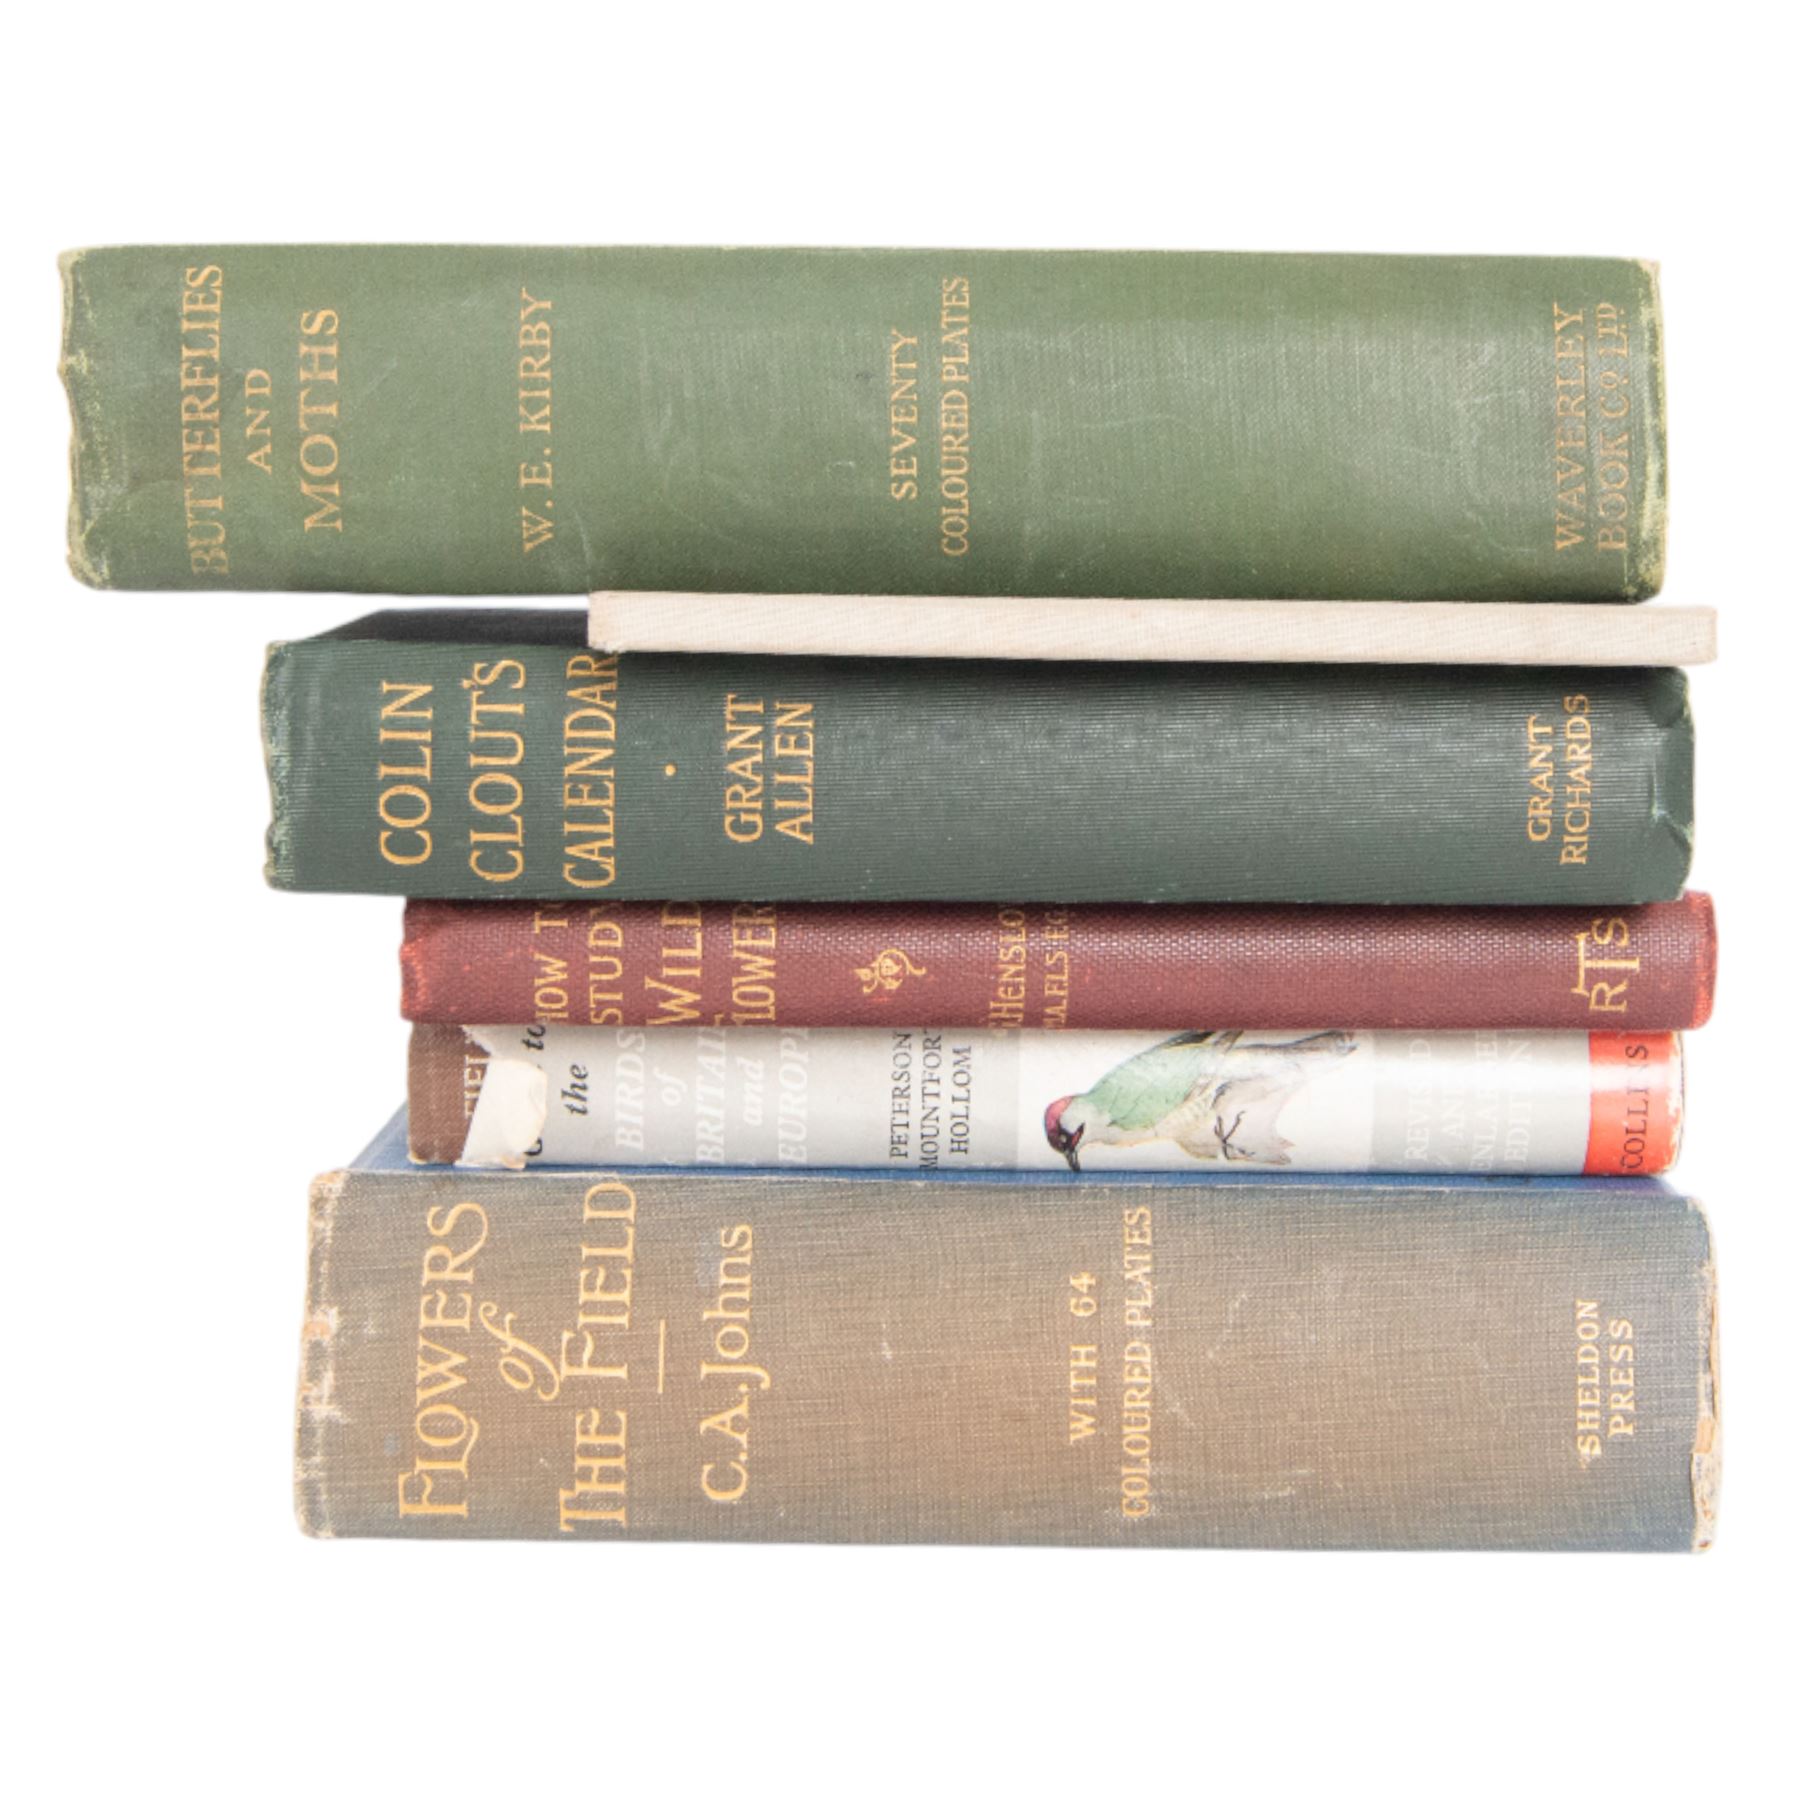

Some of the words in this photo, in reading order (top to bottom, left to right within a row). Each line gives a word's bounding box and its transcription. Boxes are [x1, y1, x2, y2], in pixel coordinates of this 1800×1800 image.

[519, 287, 552, 434] KIRBY
[941, 275, 970, 383] PLATES
[180, 264, 228, 575] BUTTERFLIES
[245, 368, 272, 475] AND
[299, 308, 342, 533] MOTHS
[519, 447, 553, 489] E.
[891, 328, 918, 500] SEVENTY
[940, 389, 970, 556] COLOURED
[1554, 302, 1587, 551] WAVERLEY
[521, 499, 554, 553] W.
[1597, 431, 1632, 551] BOOK
[379, 681, 433, 866] COLIN
[462, 659, 526, 882] CLOUT'S
[563, 651, 618, 889] CALENDAR
[724, 692, 764, 843] GRANT
[774, 700, 815, 845] ALLEN
[1528, 716, 1555, 841] GRANT
[1560, 694, 1592, 865] RICHARDS
[1572, 917, 1640, 1013] RTS
[561, 1064, 589, 1116] the
[615, 1029, 646, 1152] BIRDS
[656, 1067, 689, 1107] of
[738, 1057, 765, 1127] and
[890, 1031, 913, 1158] PETERSON
[920, 1029, 943, 1170] MOUNTFOR
[950, 1046, 972, 1155] HOLLOM
[1620, 1044, 1650, 1169] COLLIS
[561, 1182, 637, 1380] FIELD
[1070, 1271, 1097, 1317] 64
[1124, 1206, 1151, 1327] PLATES
[399, 1202, 489, 1518] FLOWERS
[478, 1301, 561, 1401] of
[1070, 1344, 1097, 1445] WITH
[1576, 1299, 1602, 1456] SHELDON
[1608, 1319, 1635, 1439] PRESS
[560, 1409, 627, 1532] THE
[1121, 1340, 1151, 1518] COLOURED
